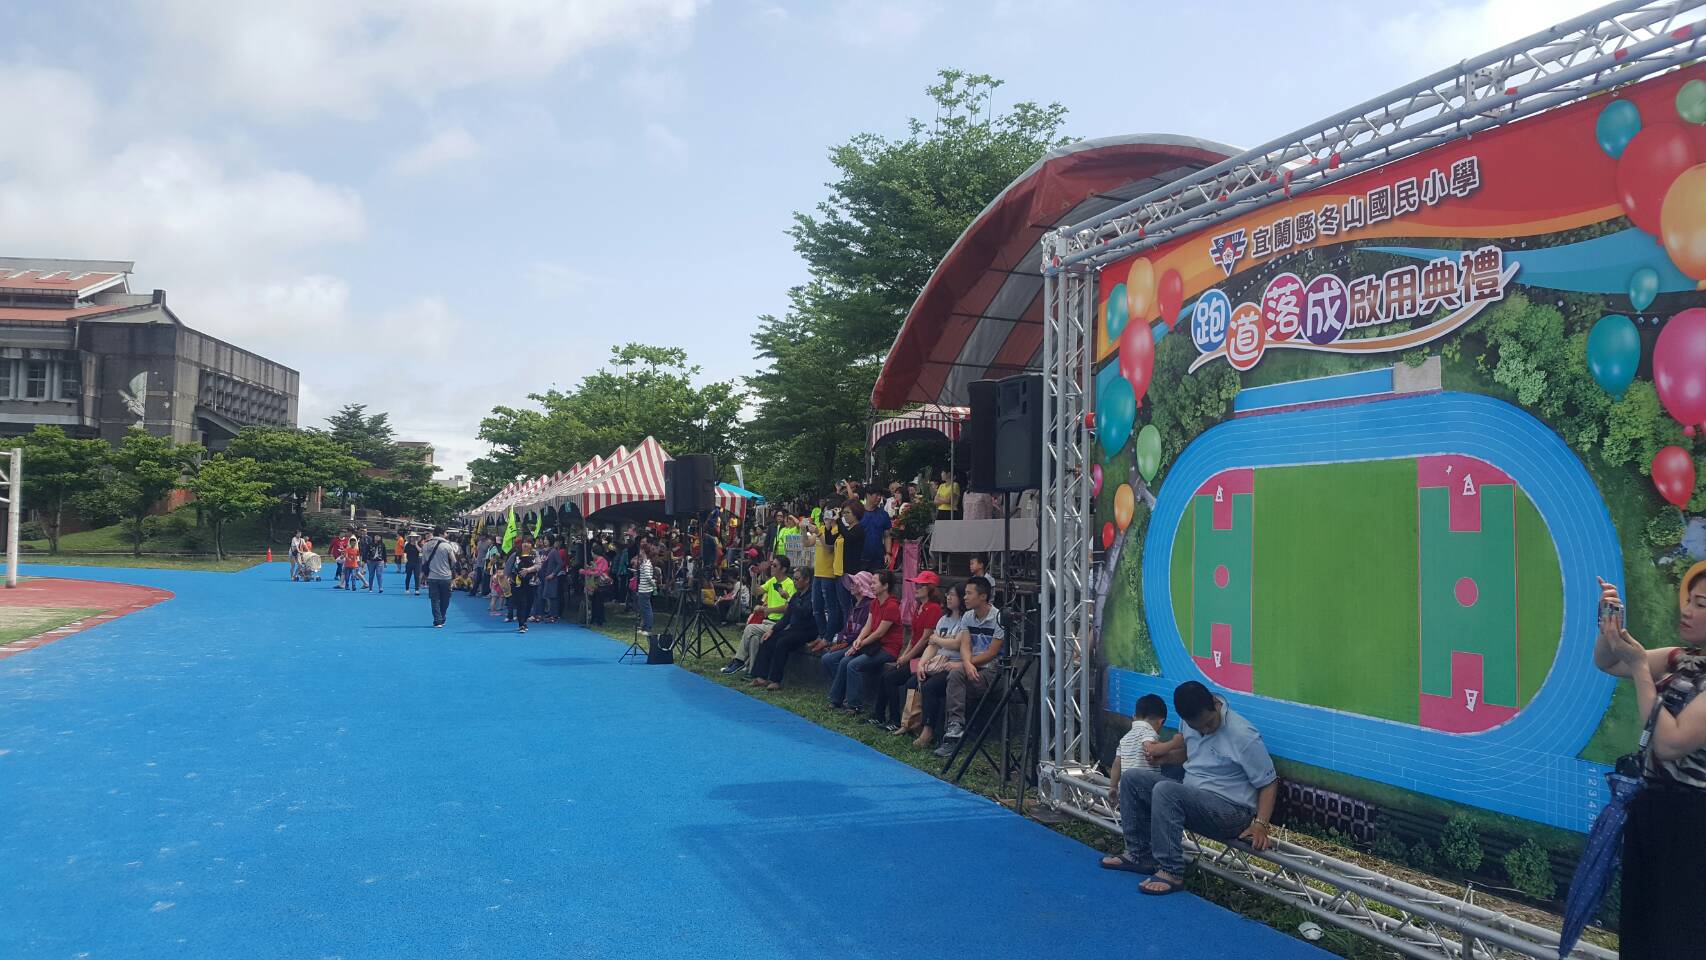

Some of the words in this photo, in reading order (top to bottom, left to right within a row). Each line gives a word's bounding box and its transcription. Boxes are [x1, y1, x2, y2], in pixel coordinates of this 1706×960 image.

[1252, 157, 1479, 257] 宜蘭縣冬山國民小學
[1194, 248, 1502, 361] 跑道落成啟用典禮
[1588, 778, 1597, 786] 2
[1588, 789, 1597, 797] 3
[1588, 801, 1597, 809] 4
